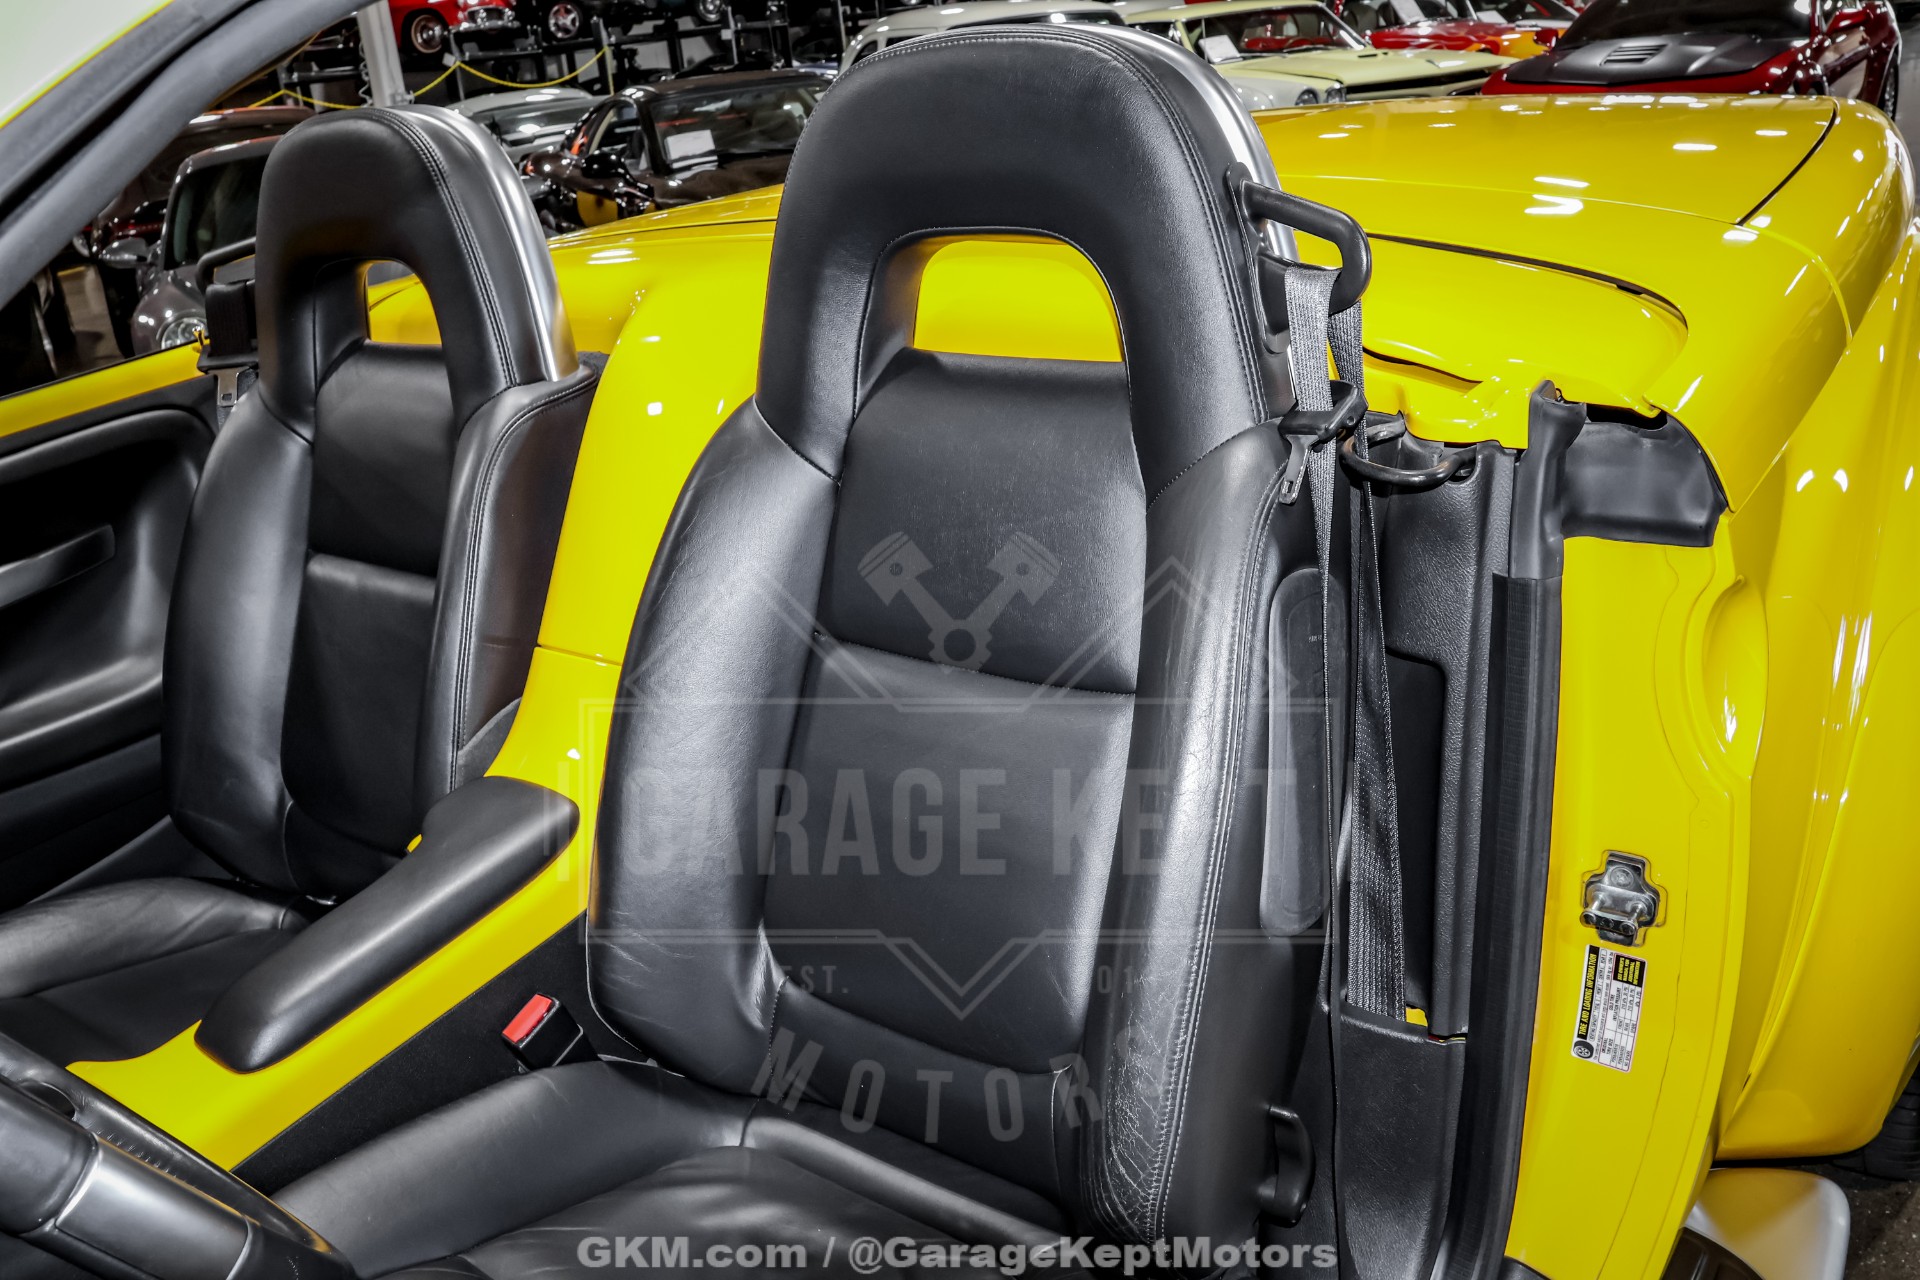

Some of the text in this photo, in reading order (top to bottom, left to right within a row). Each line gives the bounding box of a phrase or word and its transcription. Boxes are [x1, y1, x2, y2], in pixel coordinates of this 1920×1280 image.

[1579, 954, 1597, 1035] TIRE AND LOADING INFORMATION
